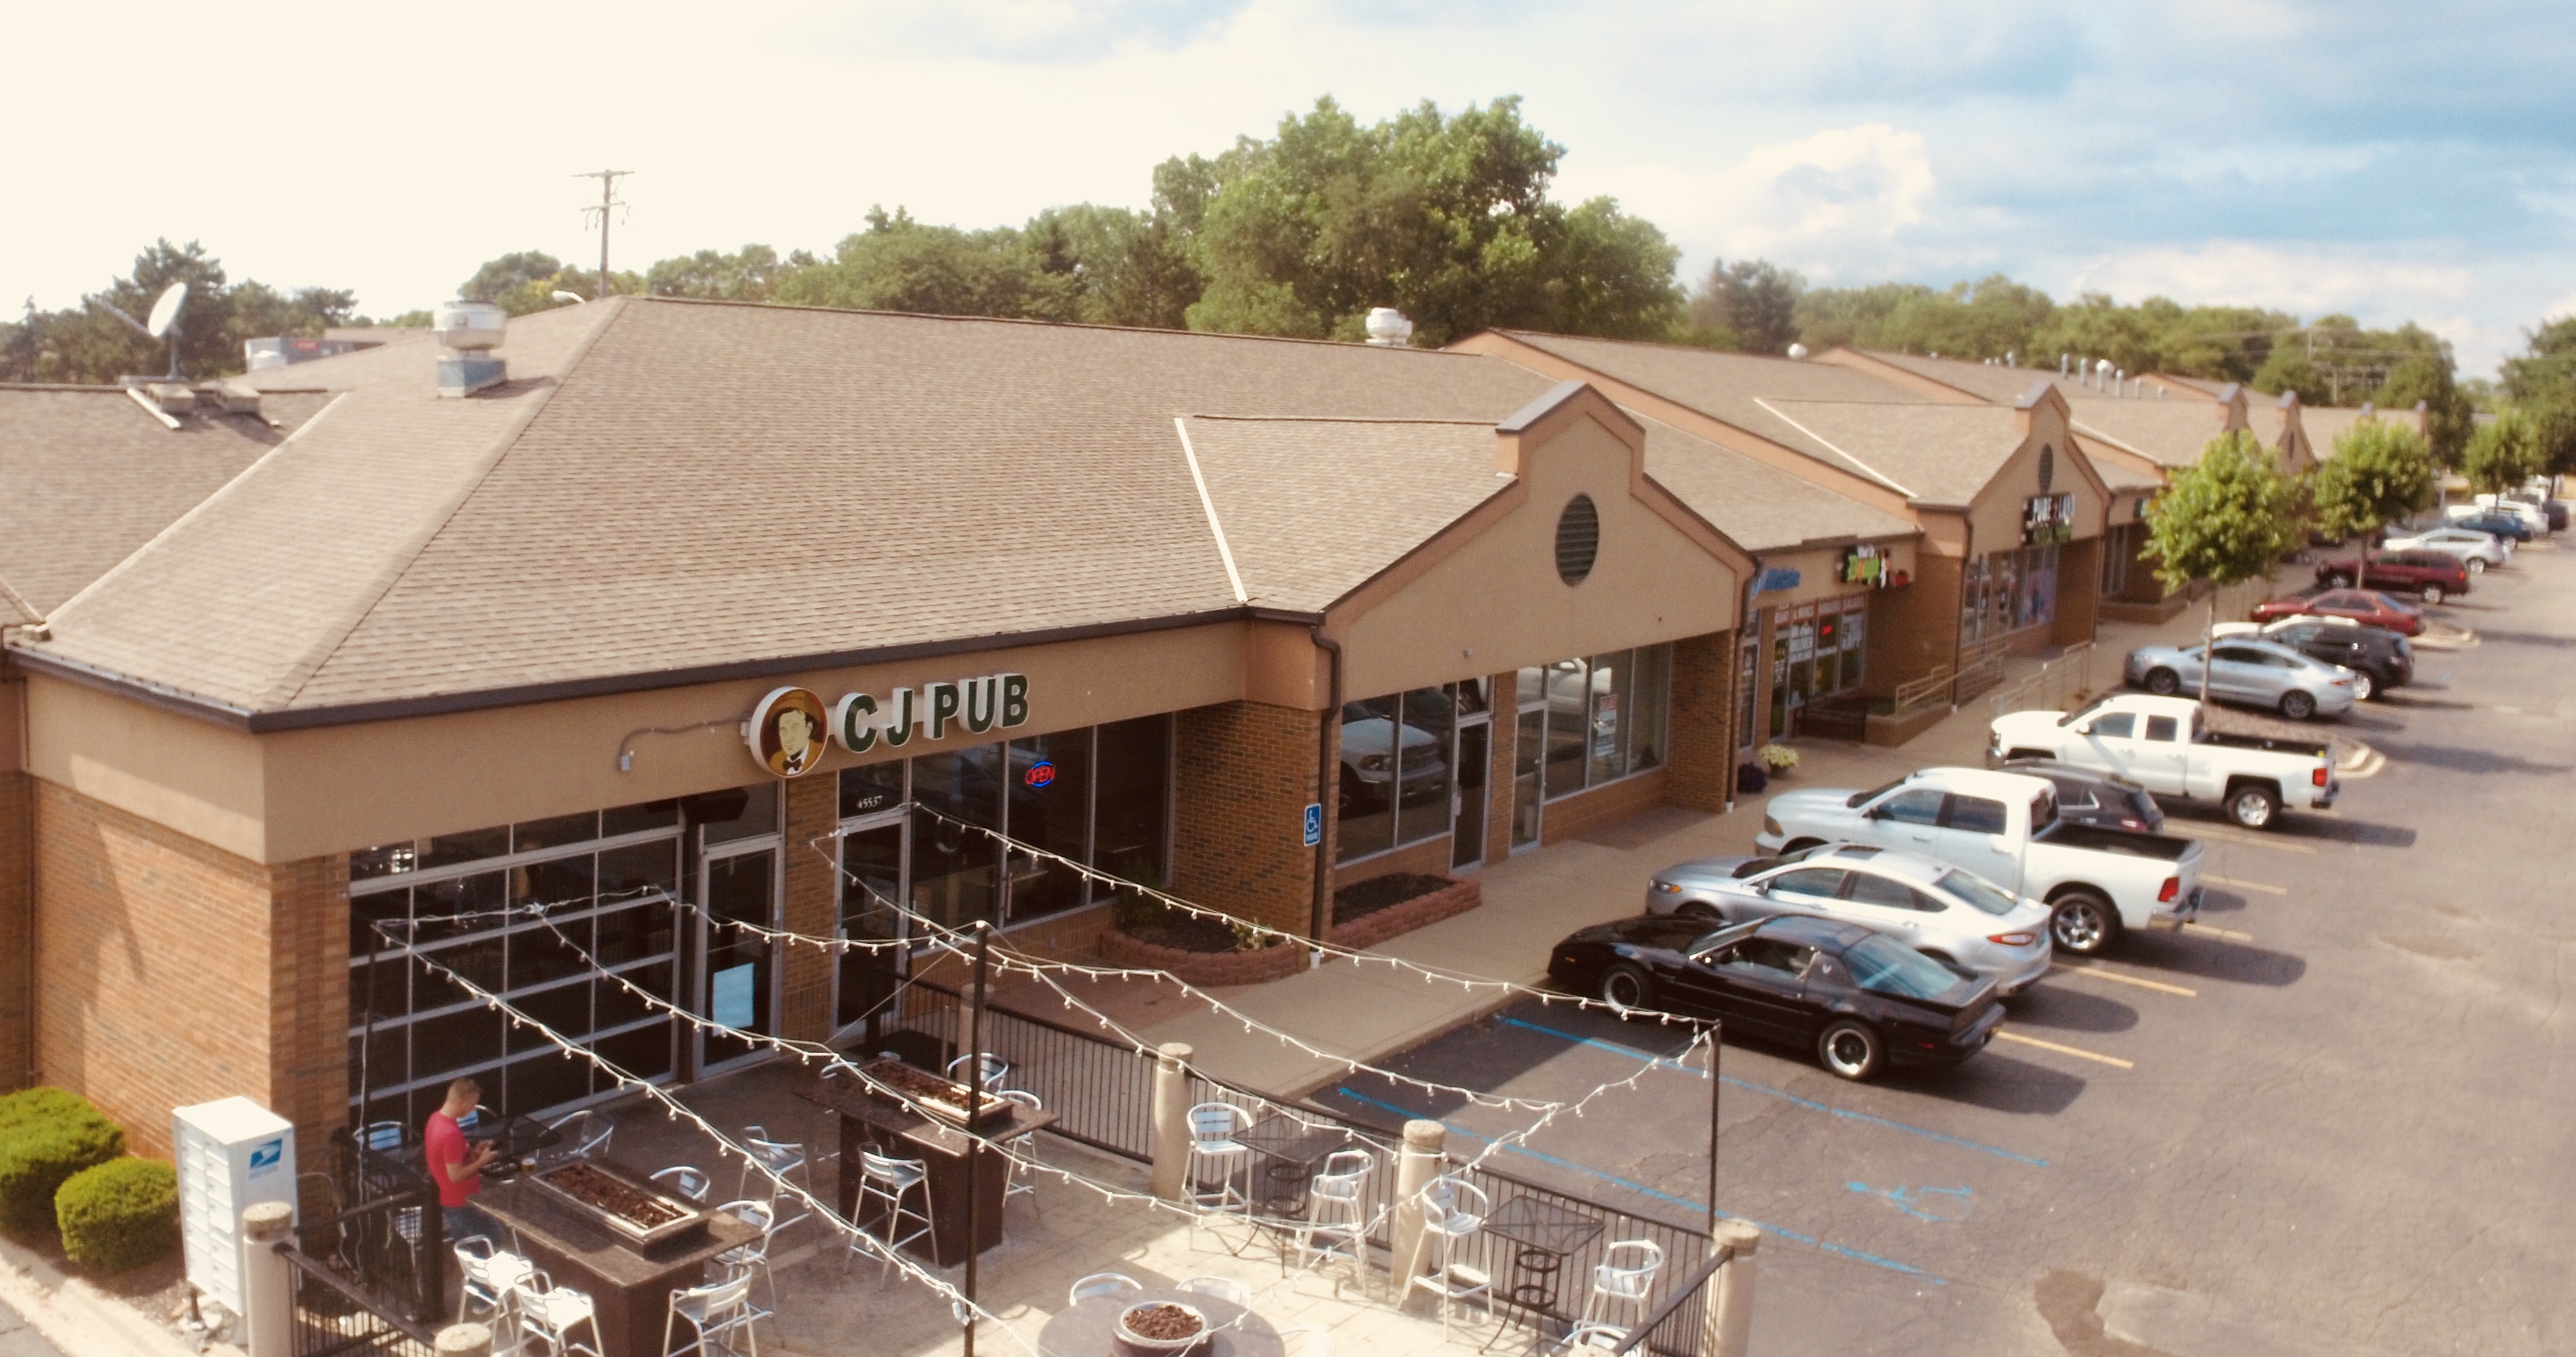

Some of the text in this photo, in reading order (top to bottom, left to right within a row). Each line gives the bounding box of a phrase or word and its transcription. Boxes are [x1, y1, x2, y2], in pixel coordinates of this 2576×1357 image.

[836, 673, 1029, 753] CJ PUB
[1025, 766, 1055, 784] OPEN
